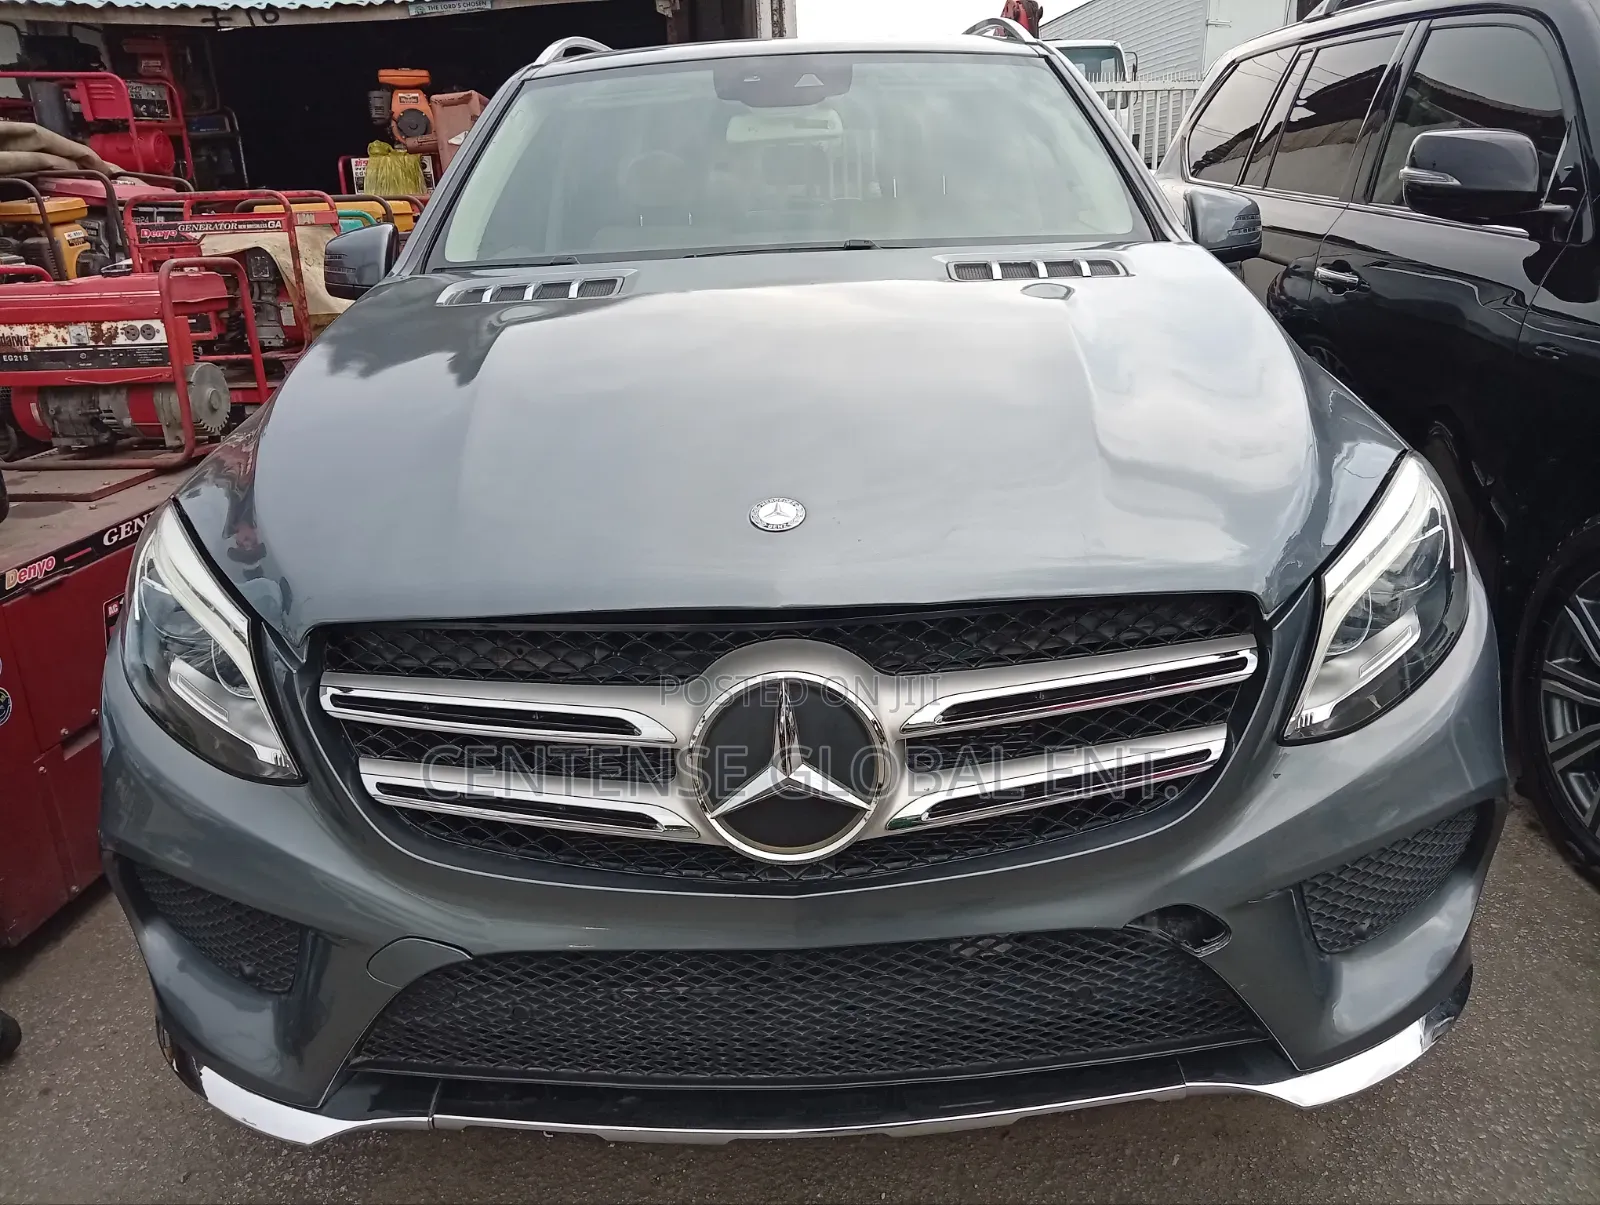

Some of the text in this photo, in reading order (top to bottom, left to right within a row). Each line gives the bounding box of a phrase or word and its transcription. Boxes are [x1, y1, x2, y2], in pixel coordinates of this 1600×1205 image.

[178, 221, 238, 232] GENERATOR
[267, 220, 282, 229] GA
[140, 229, 178, 239] Denyo
[3, 354, 29, 362] EG21S
[103, 512, 154, 546] GEN
[5, 555, 56, 590] Denyo
[108, 603, 118, 616] AC
